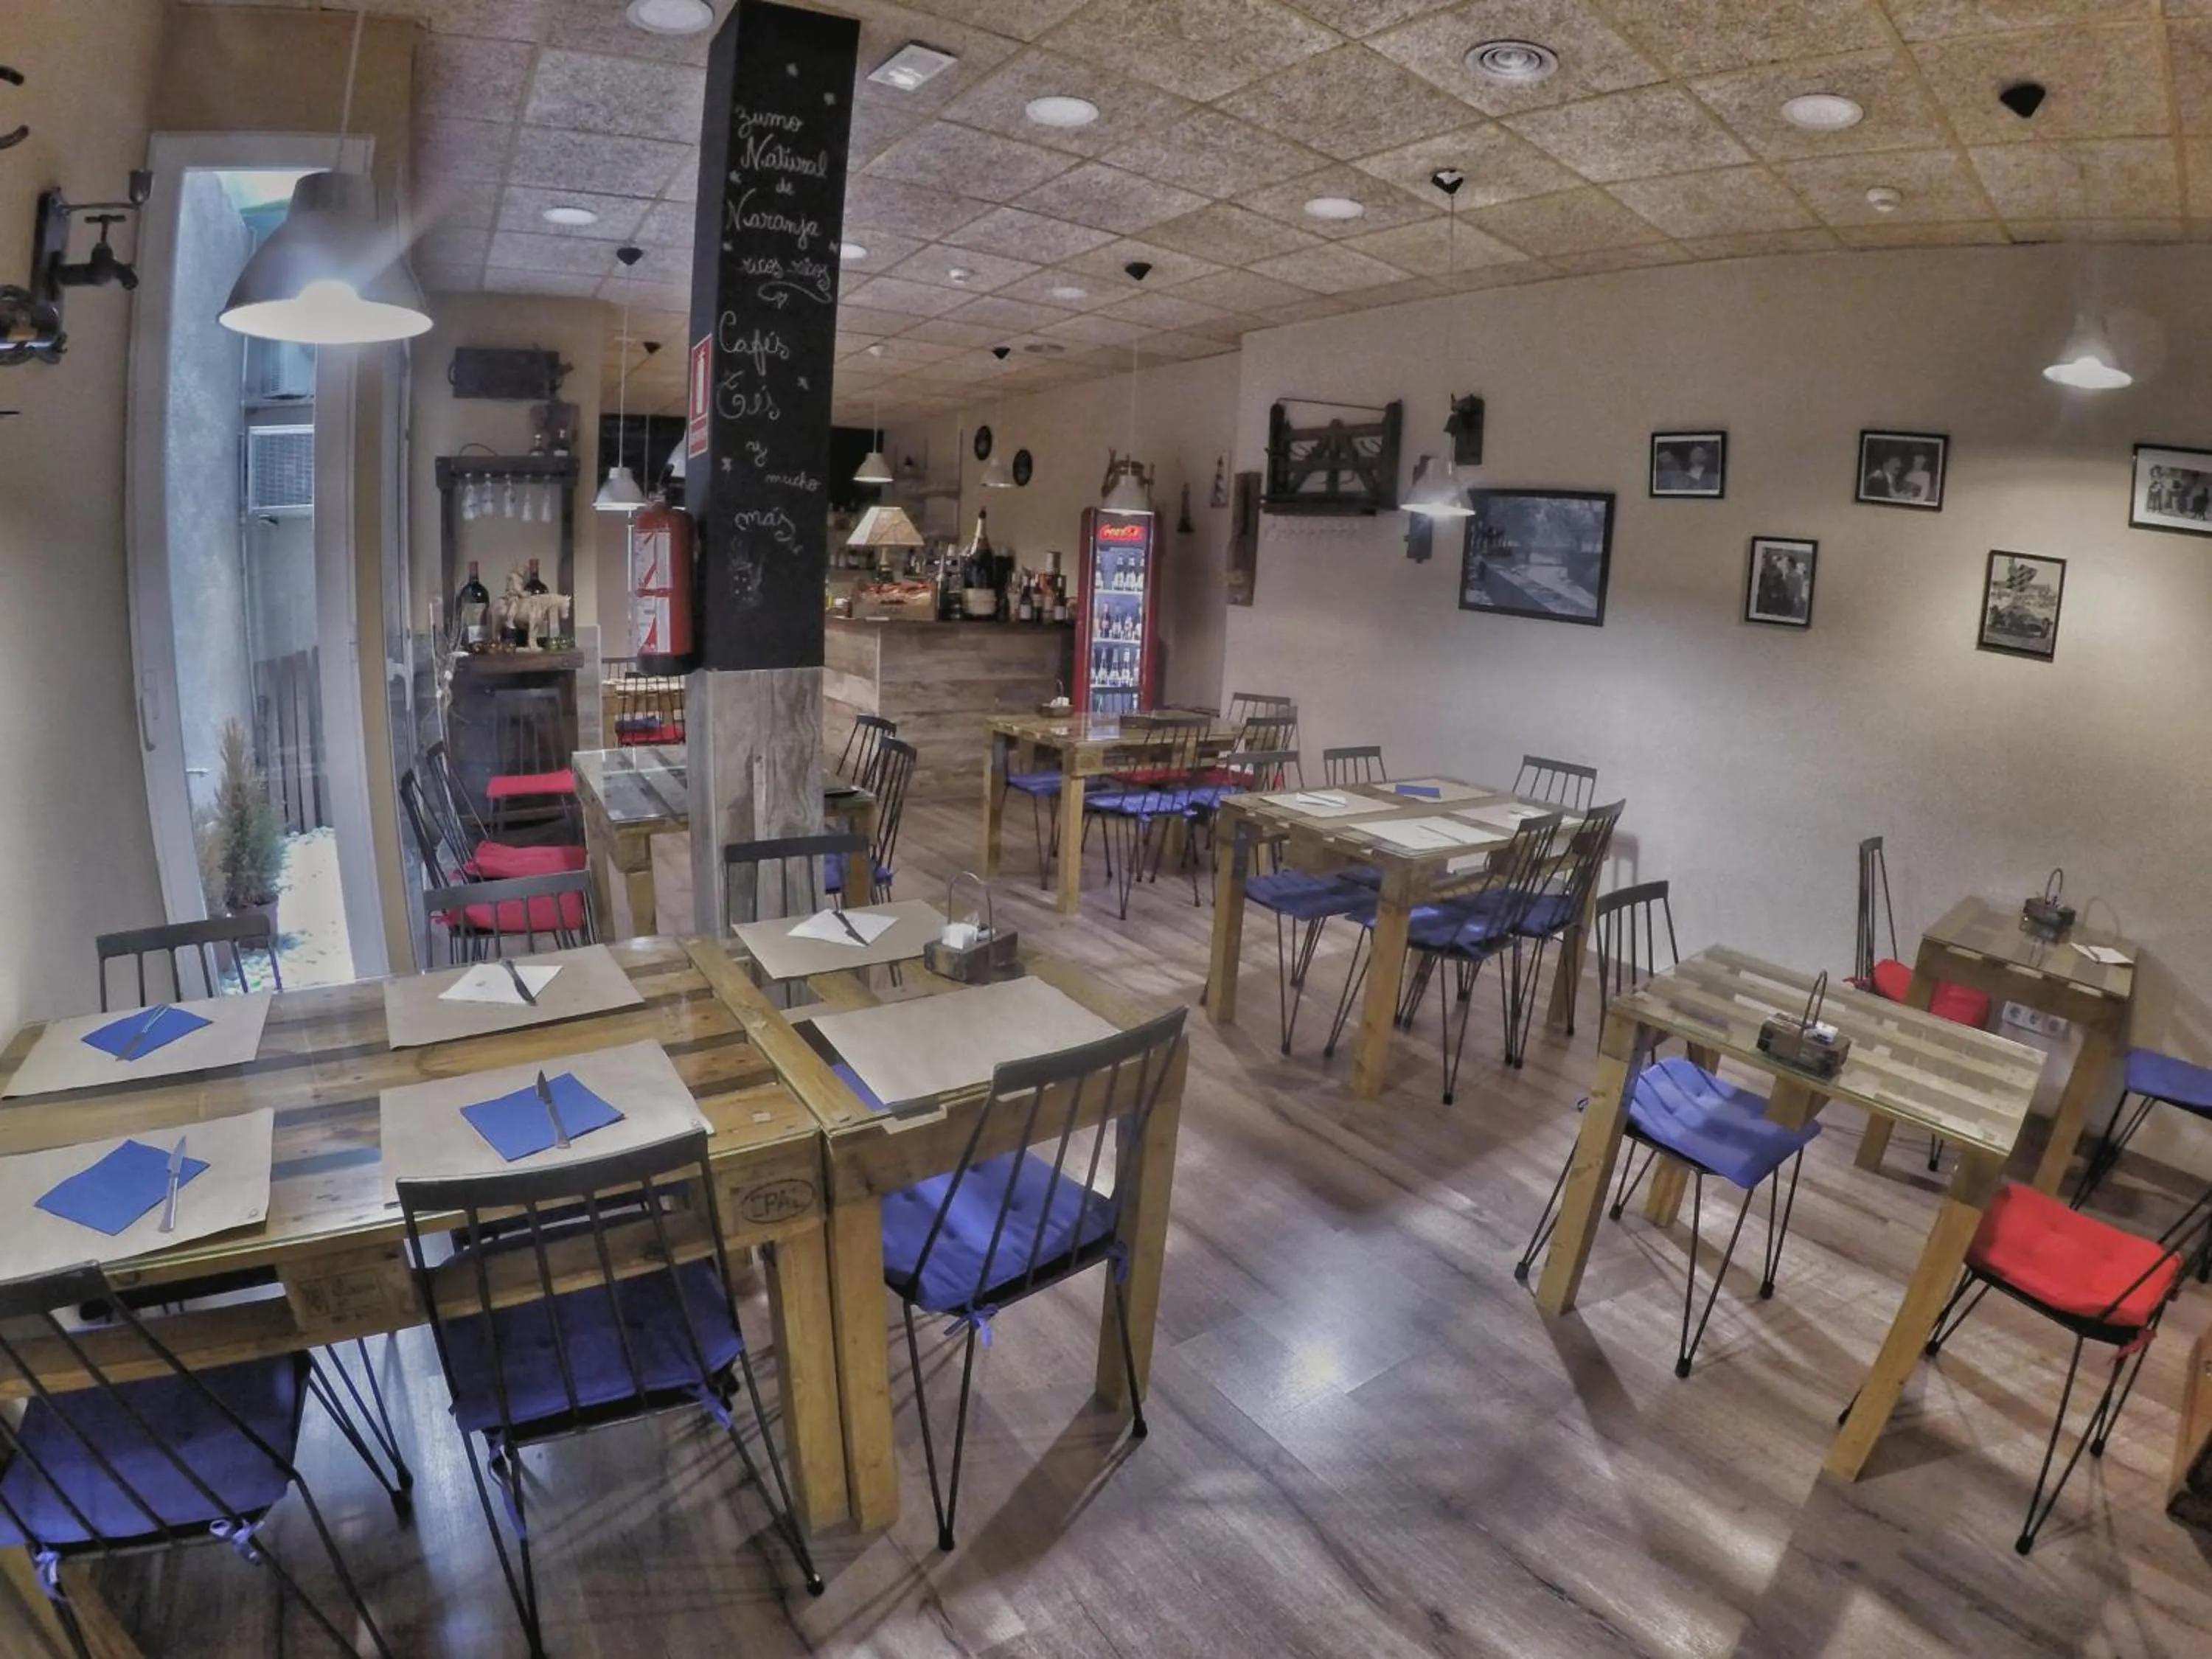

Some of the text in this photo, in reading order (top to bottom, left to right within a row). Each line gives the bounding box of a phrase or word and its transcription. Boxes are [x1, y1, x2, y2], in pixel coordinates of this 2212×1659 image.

[740, 134, 829, 180] Natural
[776, 177, 796, 195] de
[726, 189, 821, 250] Naranja
